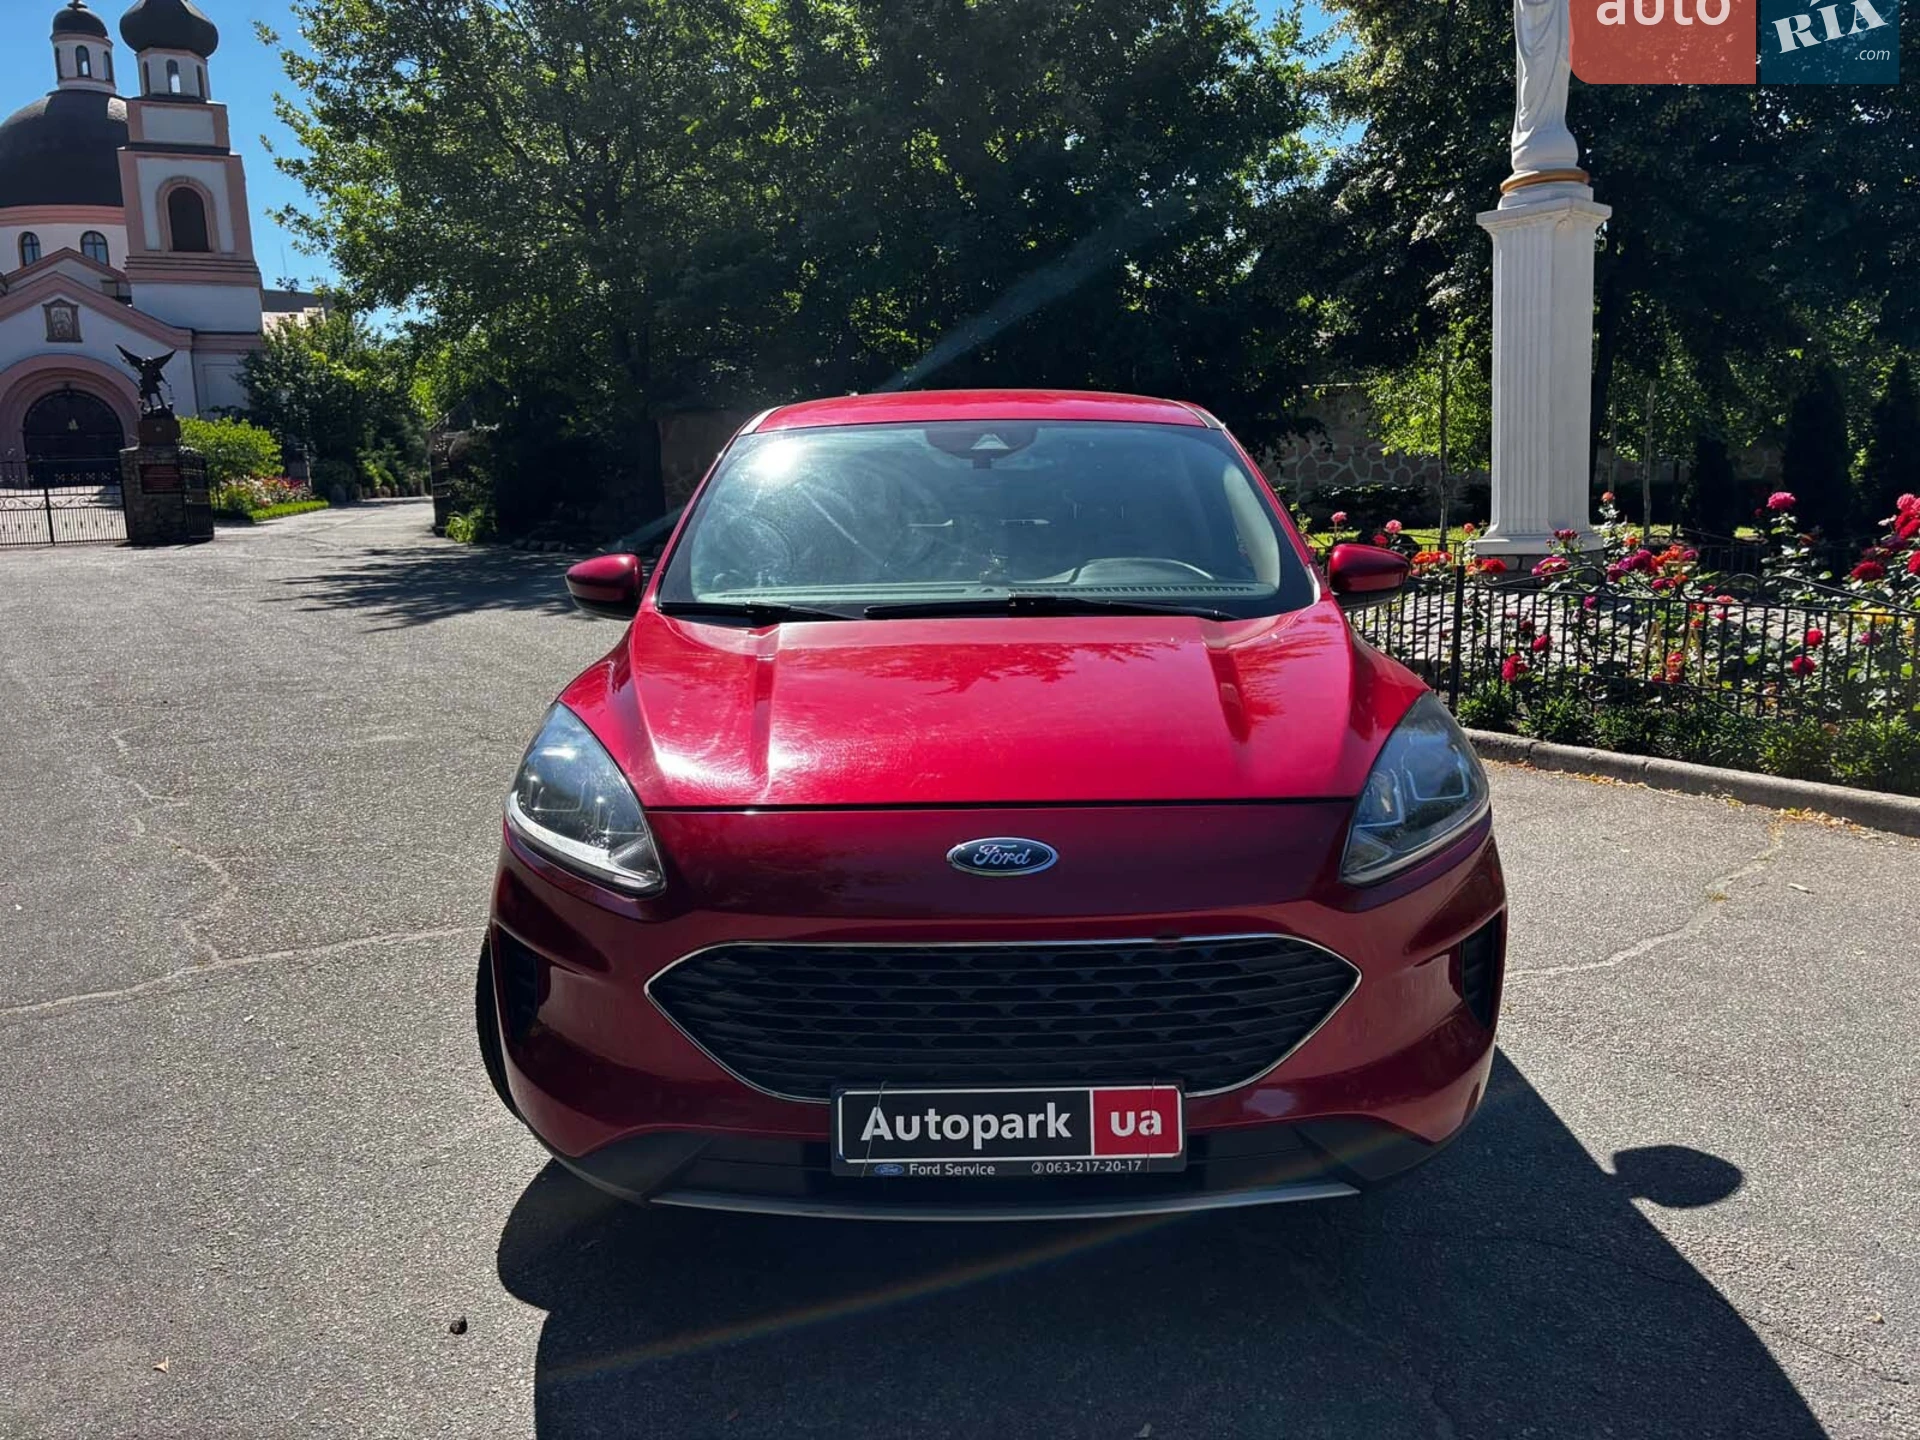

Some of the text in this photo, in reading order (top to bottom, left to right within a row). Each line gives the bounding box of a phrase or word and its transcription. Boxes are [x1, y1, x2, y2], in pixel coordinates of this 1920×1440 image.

[973, 844, 1031, 865] Ford
[860, 1102, 1163, 1150] Autopark ua
[909, 1163, 996, 1175] Ford Service
[1046, 1160, 1142, 1173] 063-217-20-17
